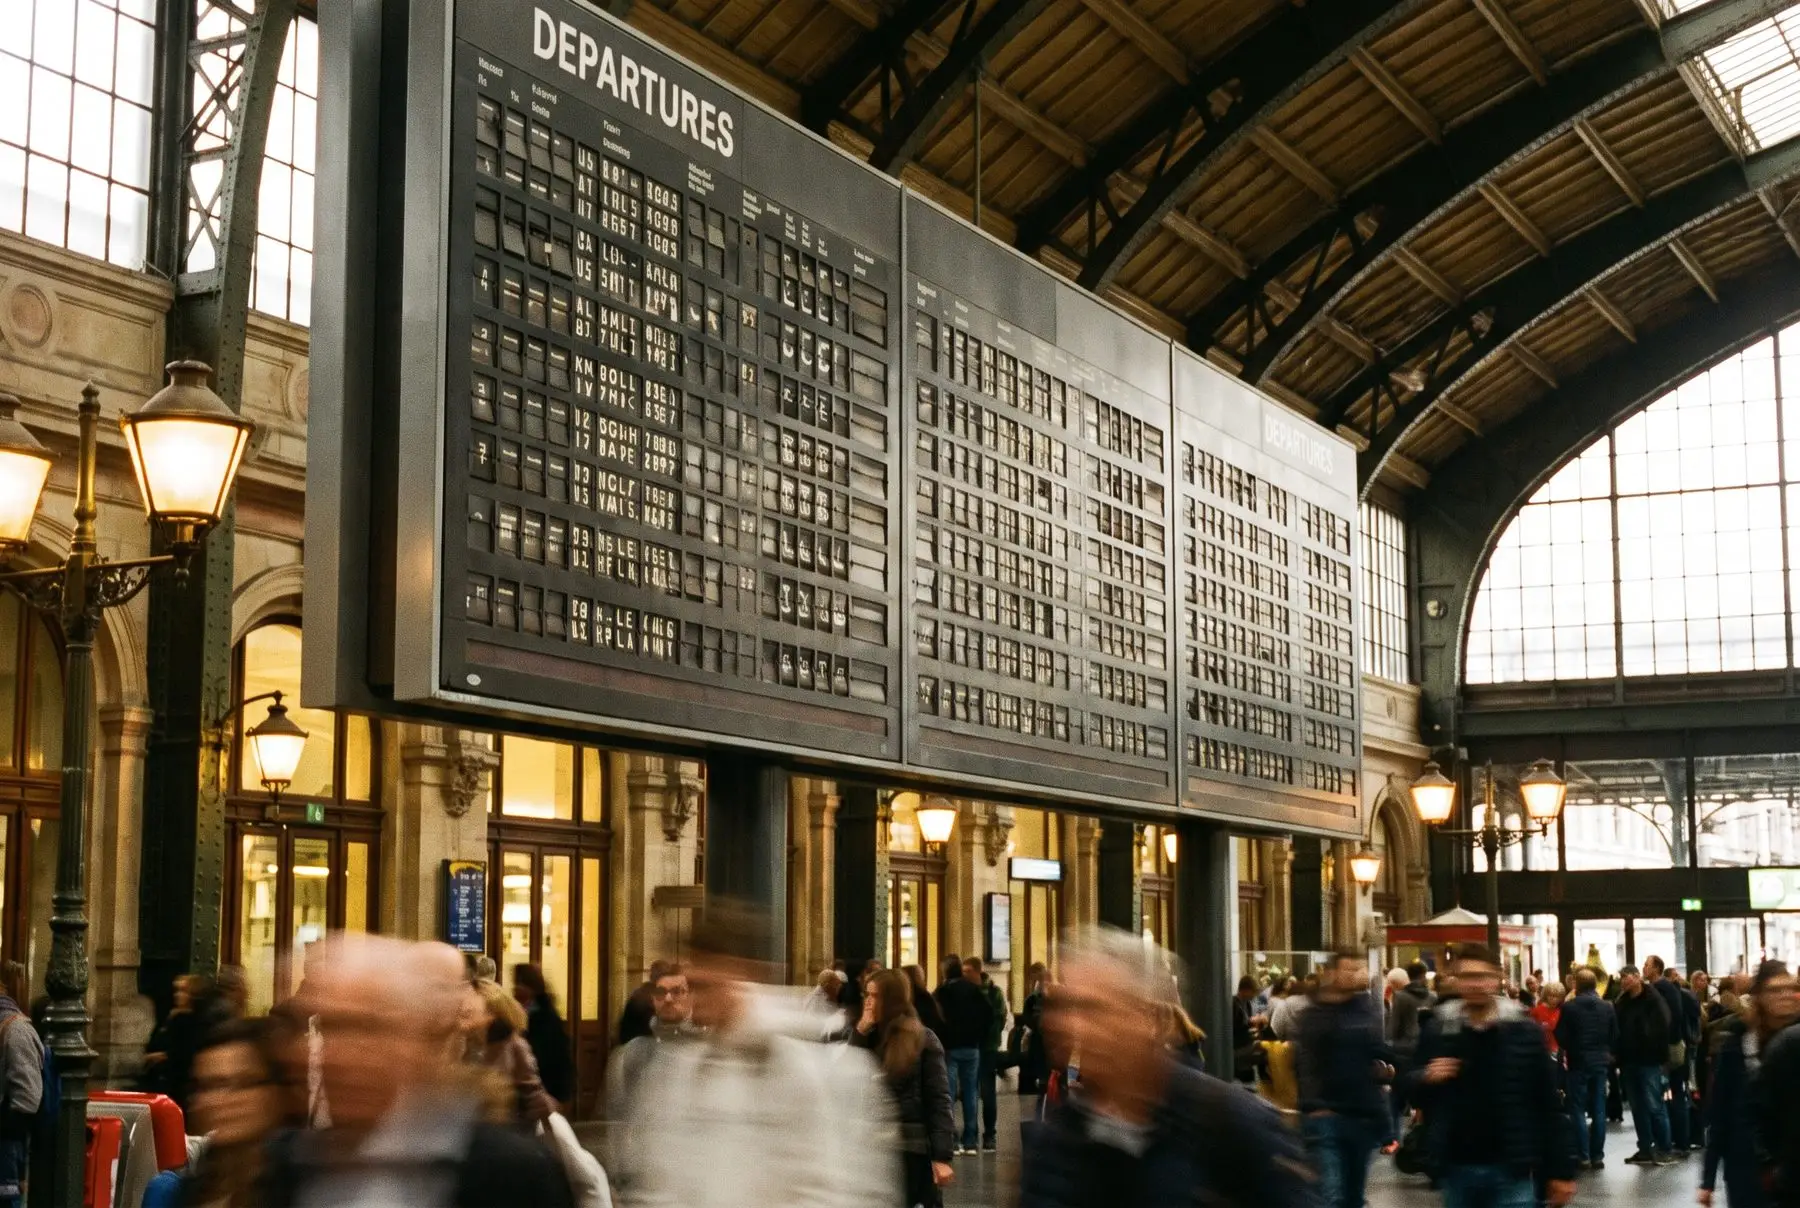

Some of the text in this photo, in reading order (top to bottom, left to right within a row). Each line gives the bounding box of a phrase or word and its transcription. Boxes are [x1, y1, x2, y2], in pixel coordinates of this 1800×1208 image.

[534, 7, 734, 158] DEPARTURES
[576, 297, 592, 318] AL
[1265, 413, 1333, 476] DEPARTURES
